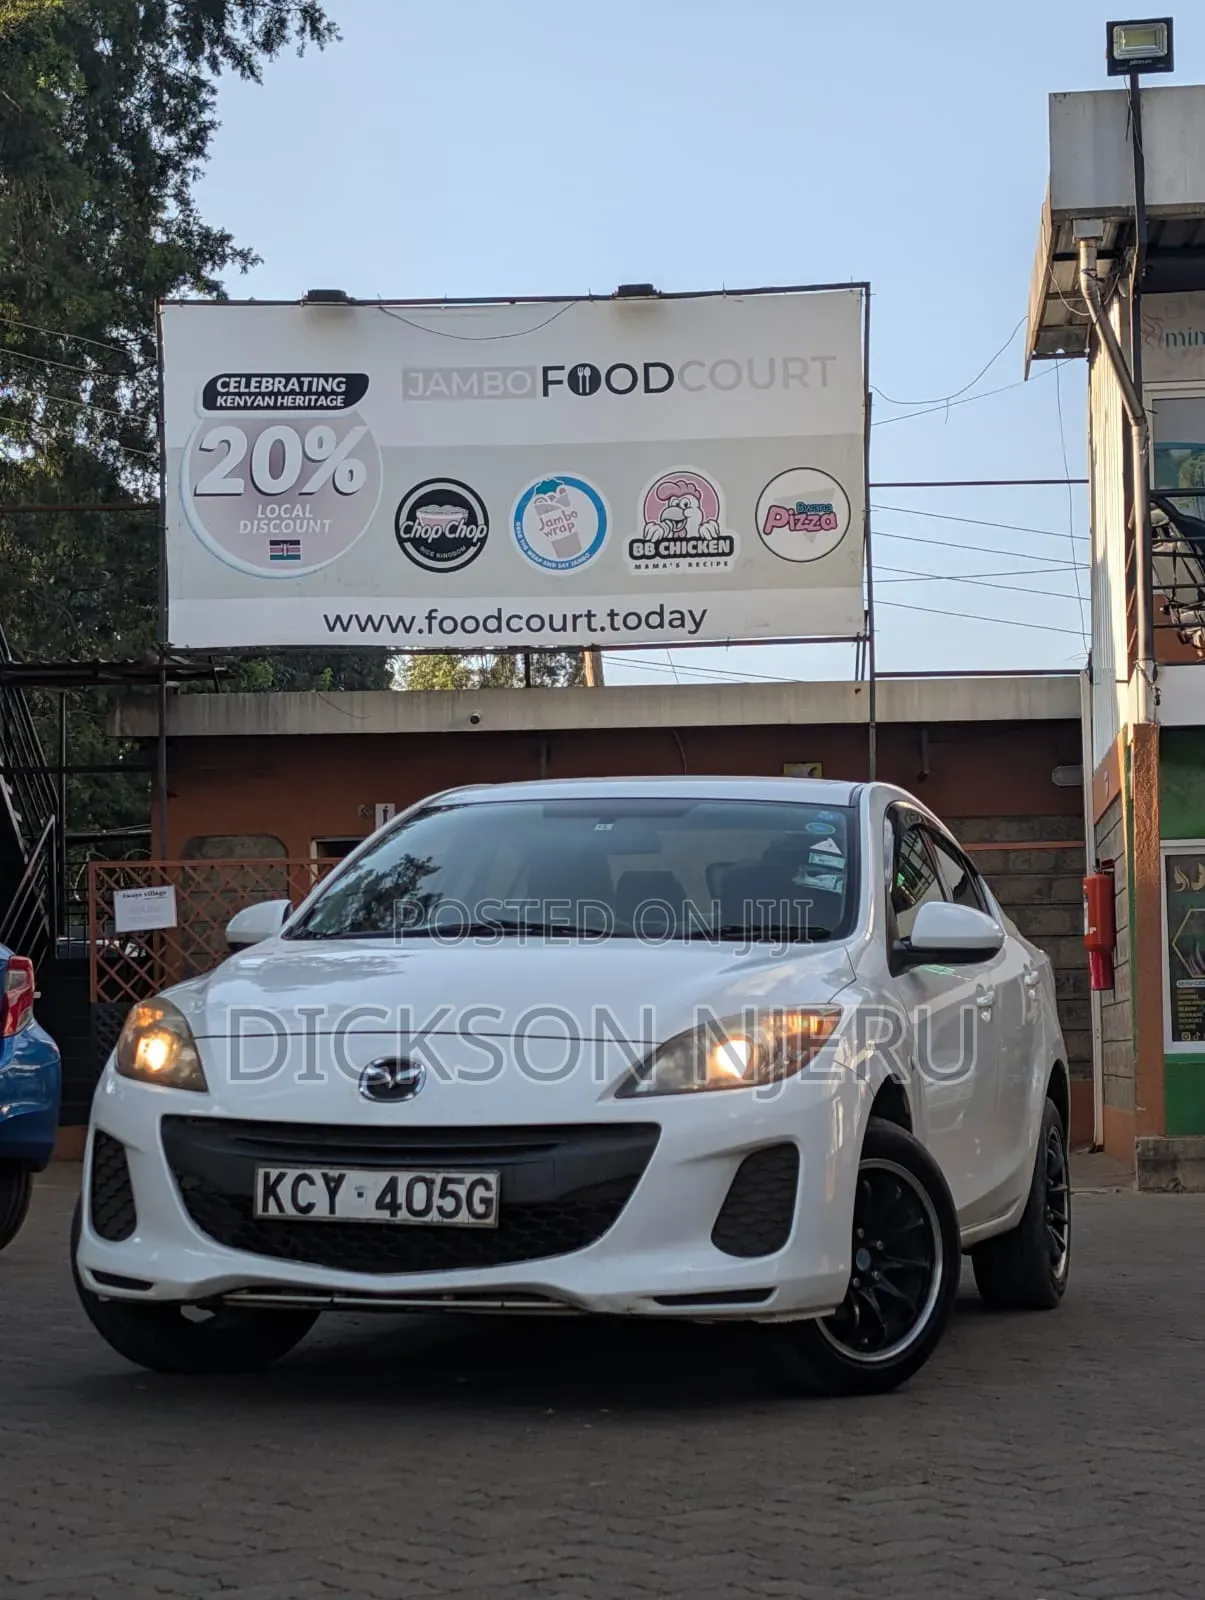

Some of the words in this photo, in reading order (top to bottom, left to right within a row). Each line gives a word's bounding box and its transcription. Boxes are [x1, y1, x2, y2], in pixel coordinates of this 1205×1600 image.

[216, 376, 346, 393] CELEBRATING
[216, 394, 275, 407] KENYAN
[277, 394, 345, 407] HERITAGE
[194, 425, 370, 497] 20%
[256, 504, 314, 519] LOCAL
[796, 502, 833, 513] Bwana
[239, 519, 333, 535] DISCOUNT
[539, 509, 578, 532] Jambo
[763, 505, 838, 535] Pizza
[399, 519, 443, 544] Chop
[444, 519, 488, 543] Chop
[543, 521, 575, 538] wrap
[632, 542, 656, 557] BB
[659, 539, 731, 556] CHICKEN
[688, 560, 728, 568] RECIPE
[323, 604, 708, 635] www.foodcourt.today
[261, 1171, 347, 1216] KCY
[375, 1174, 495, 1220] 405G
